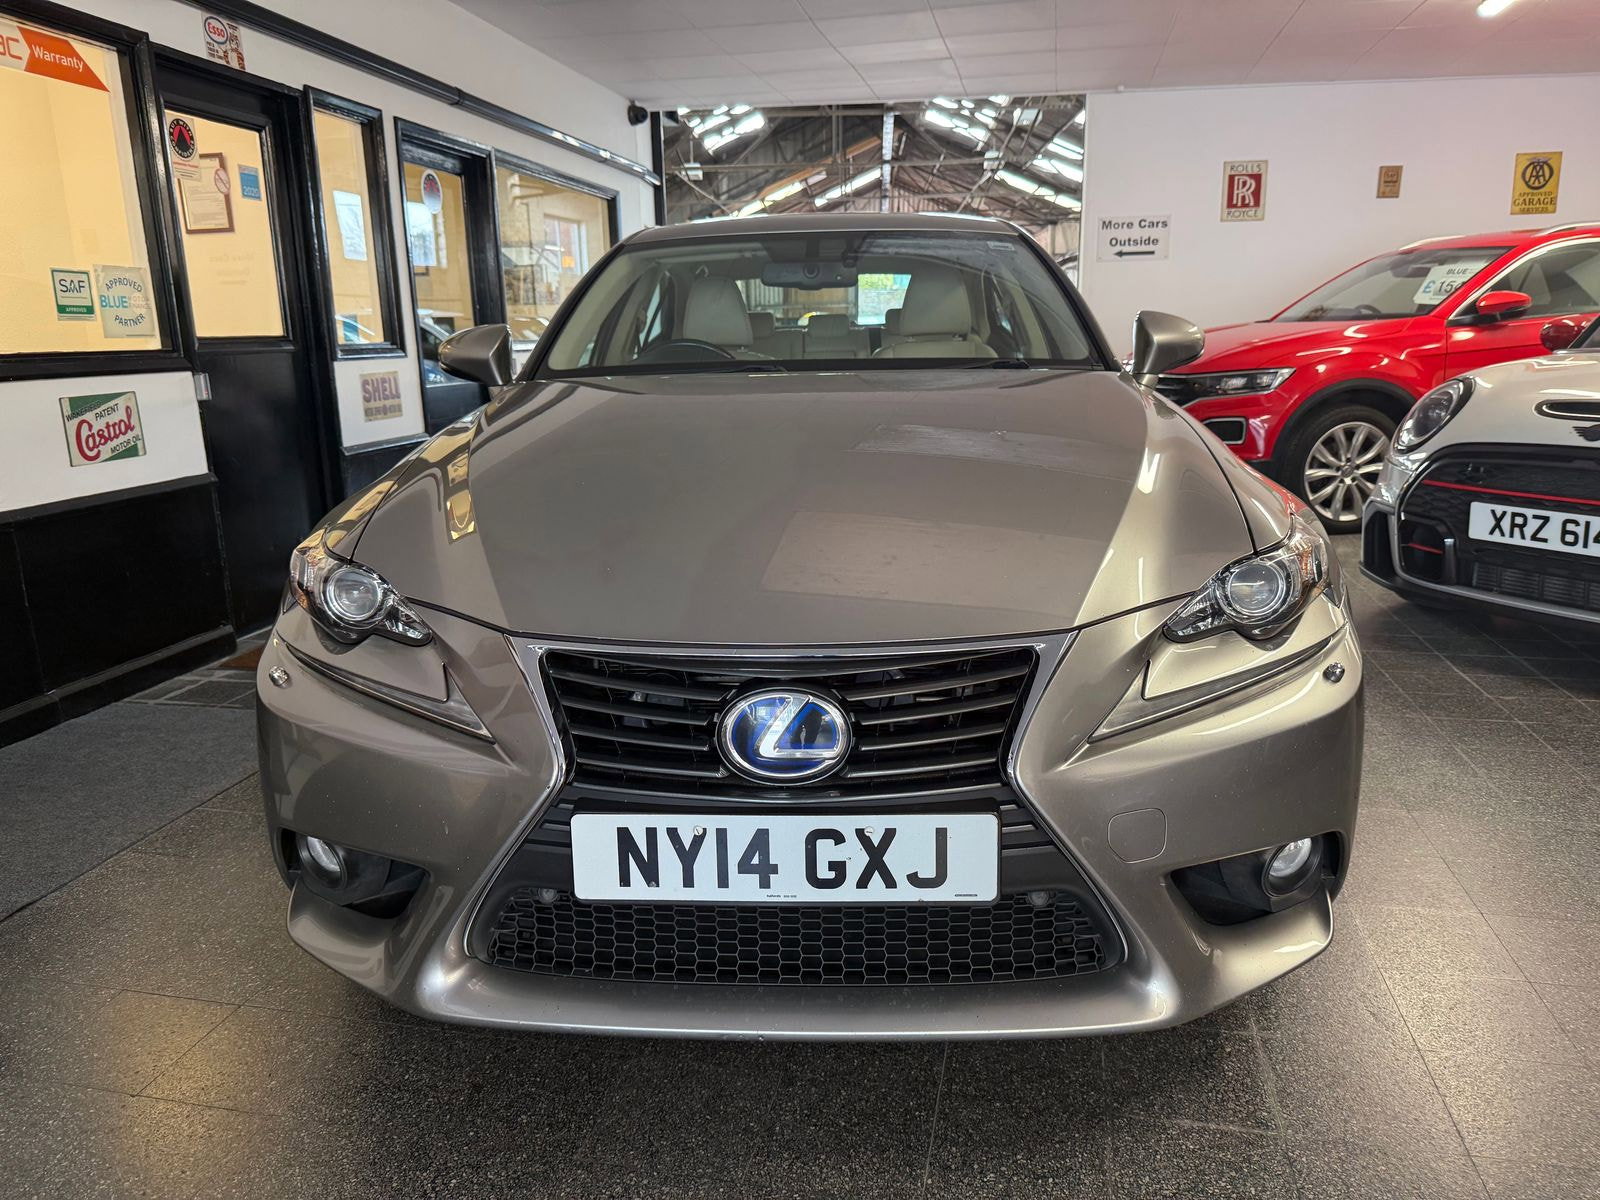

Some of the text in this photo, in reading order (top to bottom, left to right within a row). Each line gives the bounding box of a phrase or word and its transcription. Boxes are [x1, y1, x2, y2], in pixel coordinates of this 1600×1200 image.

[31, 44, 84, 72] Warranty
[1230, 164, 1262, 173] ROLLS
[1513, 197, 1556, 207] GARAGE
[1226, 209, 1259, 218] ROYCE
[1101, 218, 1168, 230] More Cars
[1109, 236, 1159, 247] Outside
[58, 278, 86, 293] SAF
[105, 277, 143, 292] APPROVED
[100, 294, 129, 308] BLUE
[114, 313, 146, 327] PARTNER
[361, 376, 401, 403] SHELL
[94, 403, 119, 421] PATENT
[75, 405, 135, 461] Castrol
[110, 434, 142, 454] MOTOR OIL
[1488, 509, 1550, 543] XRZ
[616, 826, 948, 889] NY14 GXJ
